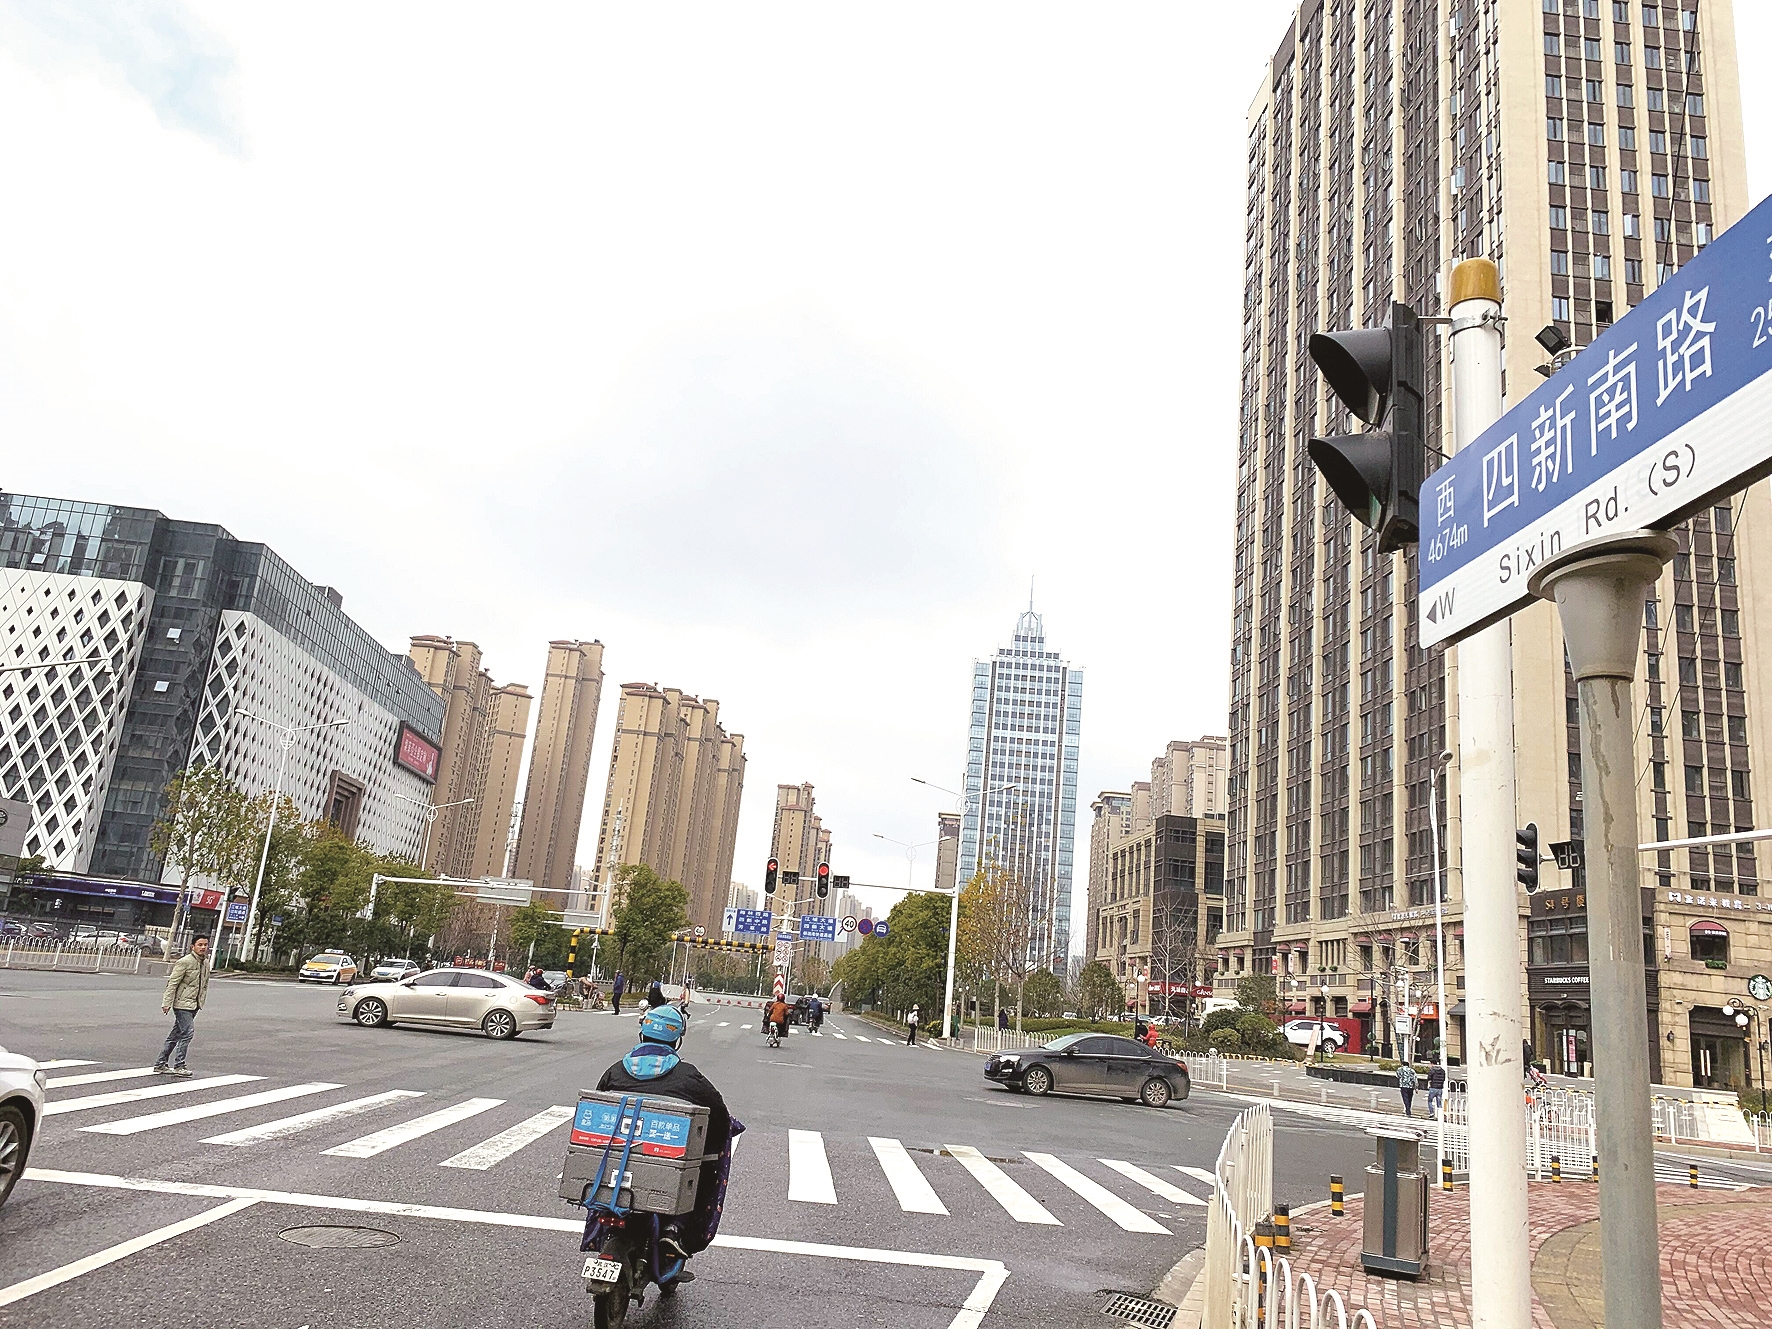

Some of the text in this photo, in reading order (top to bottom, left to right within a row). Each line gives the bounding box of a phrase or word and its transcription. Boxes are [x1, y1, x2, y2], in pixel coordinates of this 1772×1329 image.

[1481, 284, 1716, 528] 四新南路
[1435, 474, 1456, 528] 西
[1499, 442, 1697, 585] Sixin Rd. (S)
[1427, 522, 1469, 564] 4674m
[1438, 586, 1456, 620] W
[844, 920, 855, 929] 40
[1571, 976, 1590, 984] COFFEE
[648, 1129, 680, 1140] 买一送一
[583, 1265, 615, 1280] P3547
